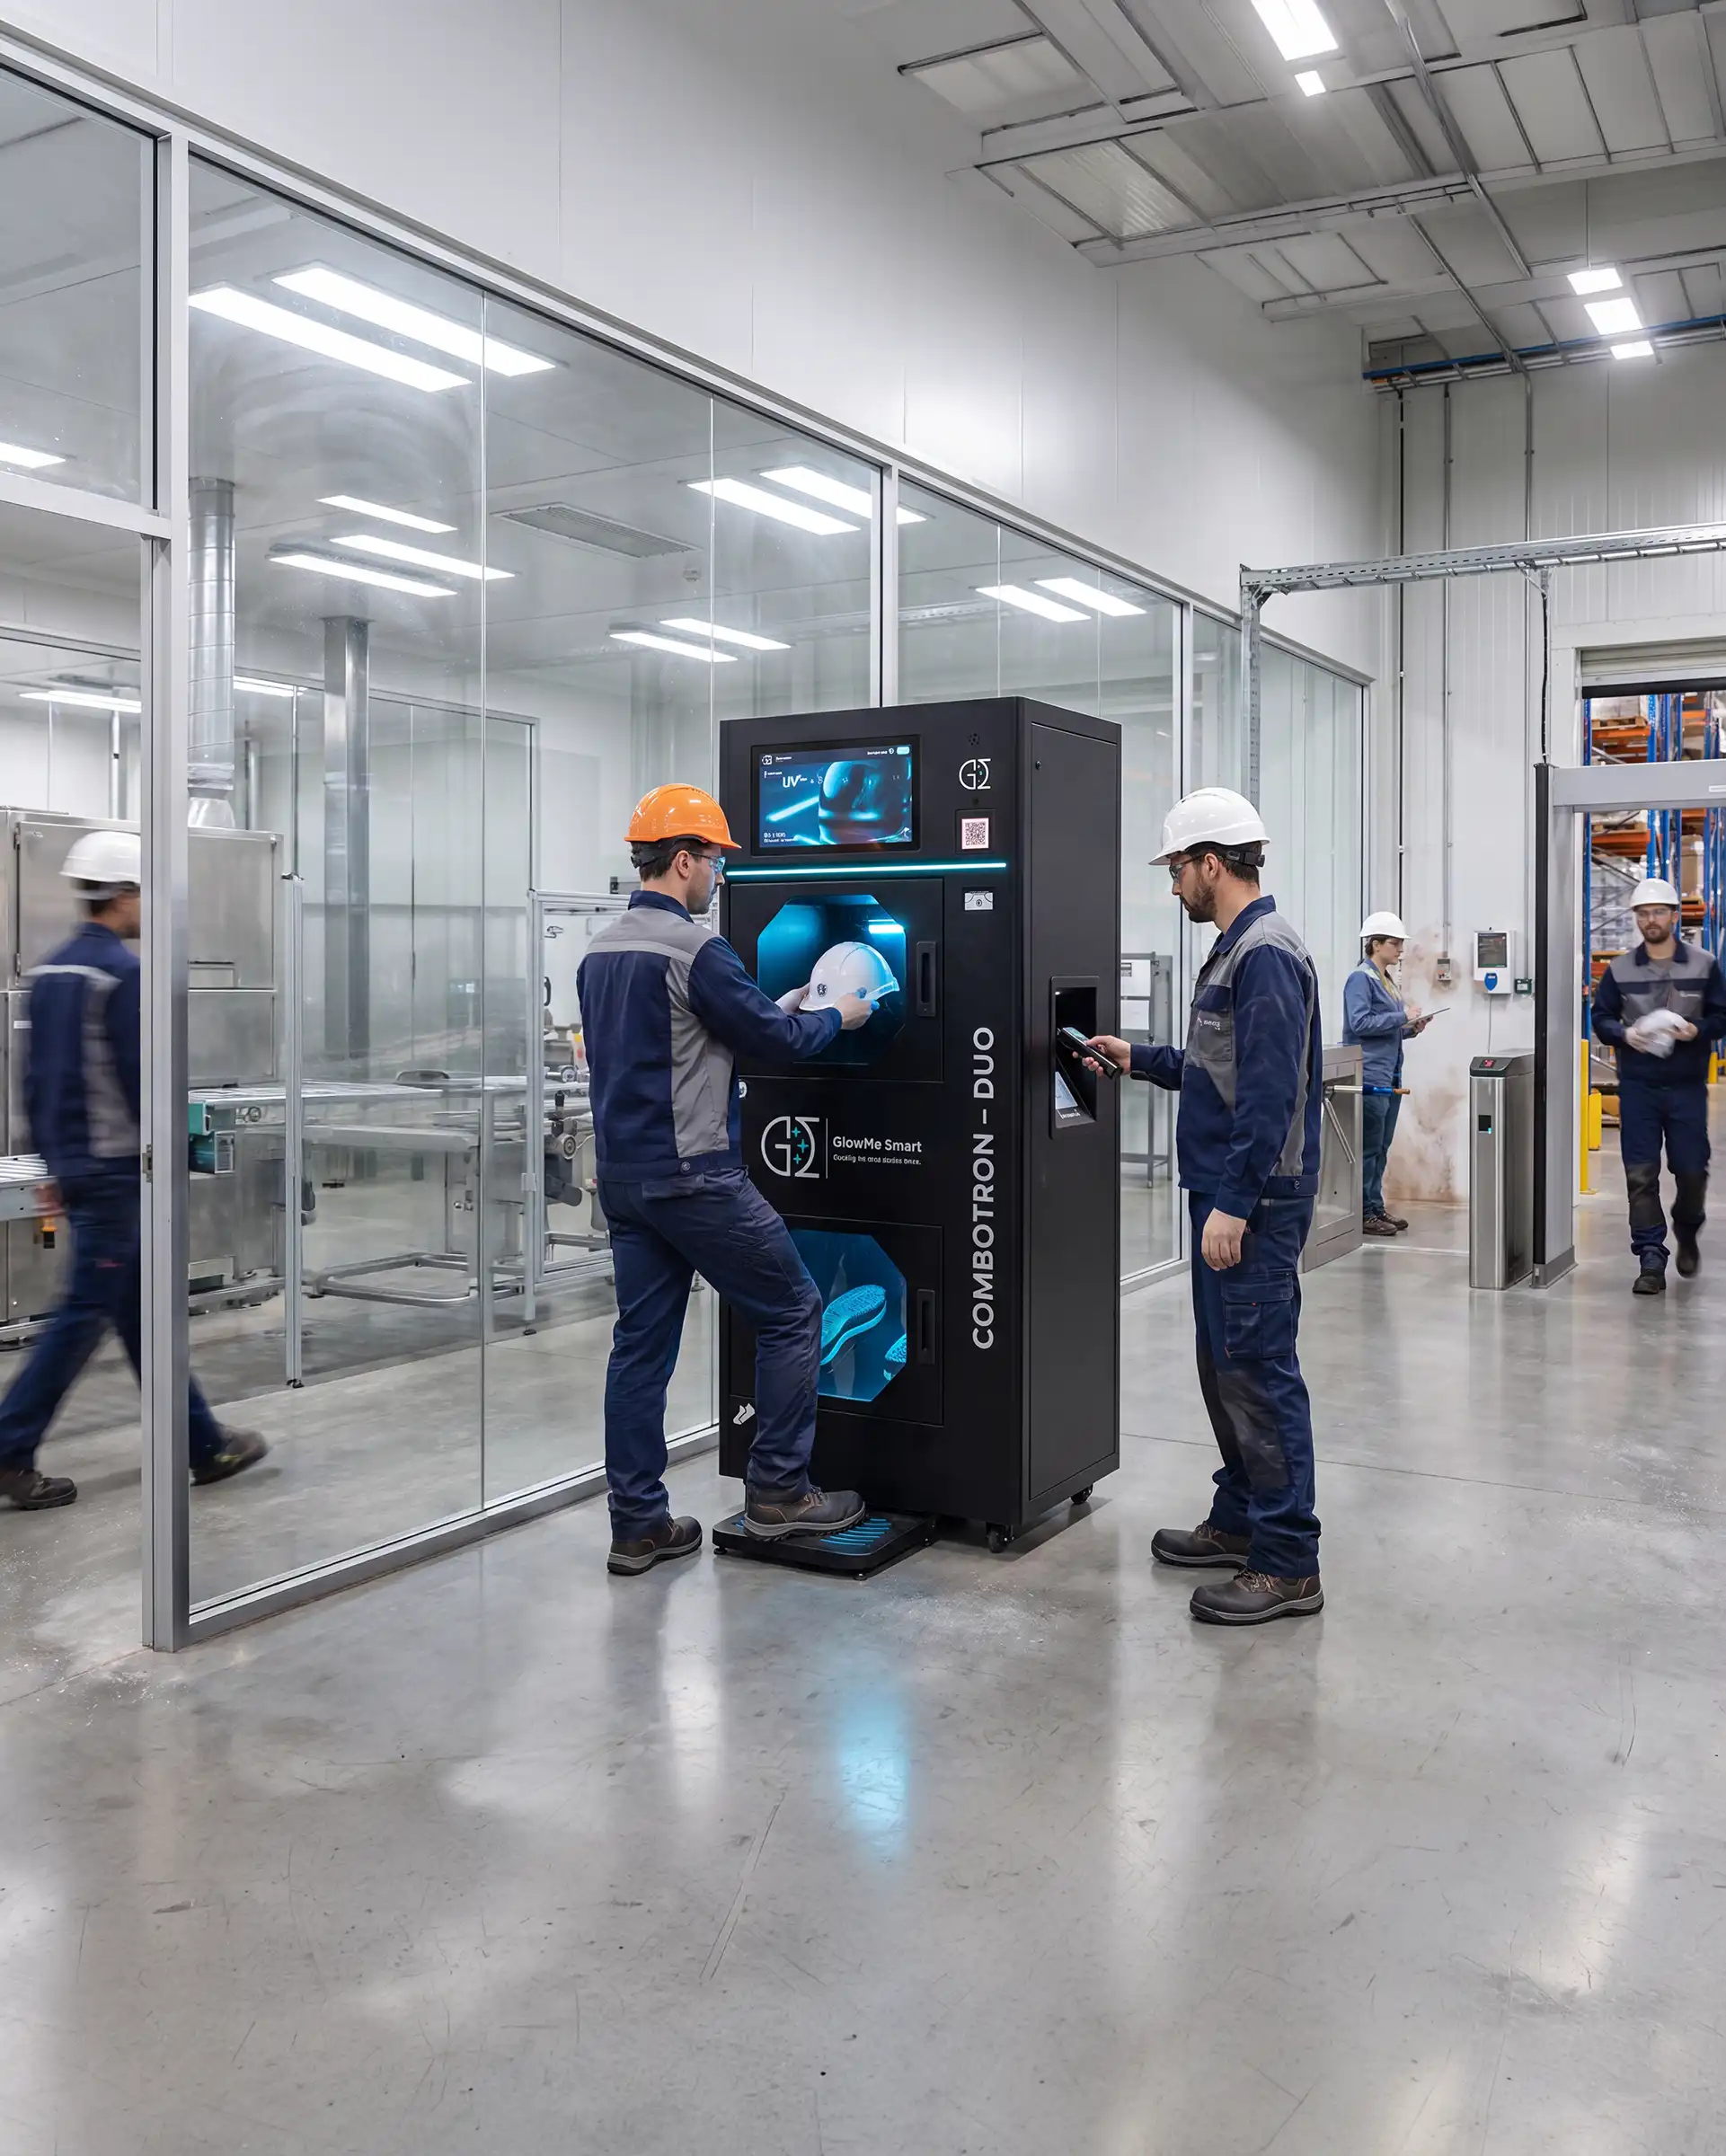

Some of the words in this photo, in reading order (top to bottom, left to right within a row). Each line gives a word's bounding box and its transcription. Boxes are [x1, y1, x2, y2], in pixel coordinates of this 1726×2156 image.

[972, 1027, 995, 1100] DUO
[832, 1135, 882, 1151] GlowMe
[884, 1138, 923, 1153] Smart
[972, 1134, 995, 1349] COMBOTRON
